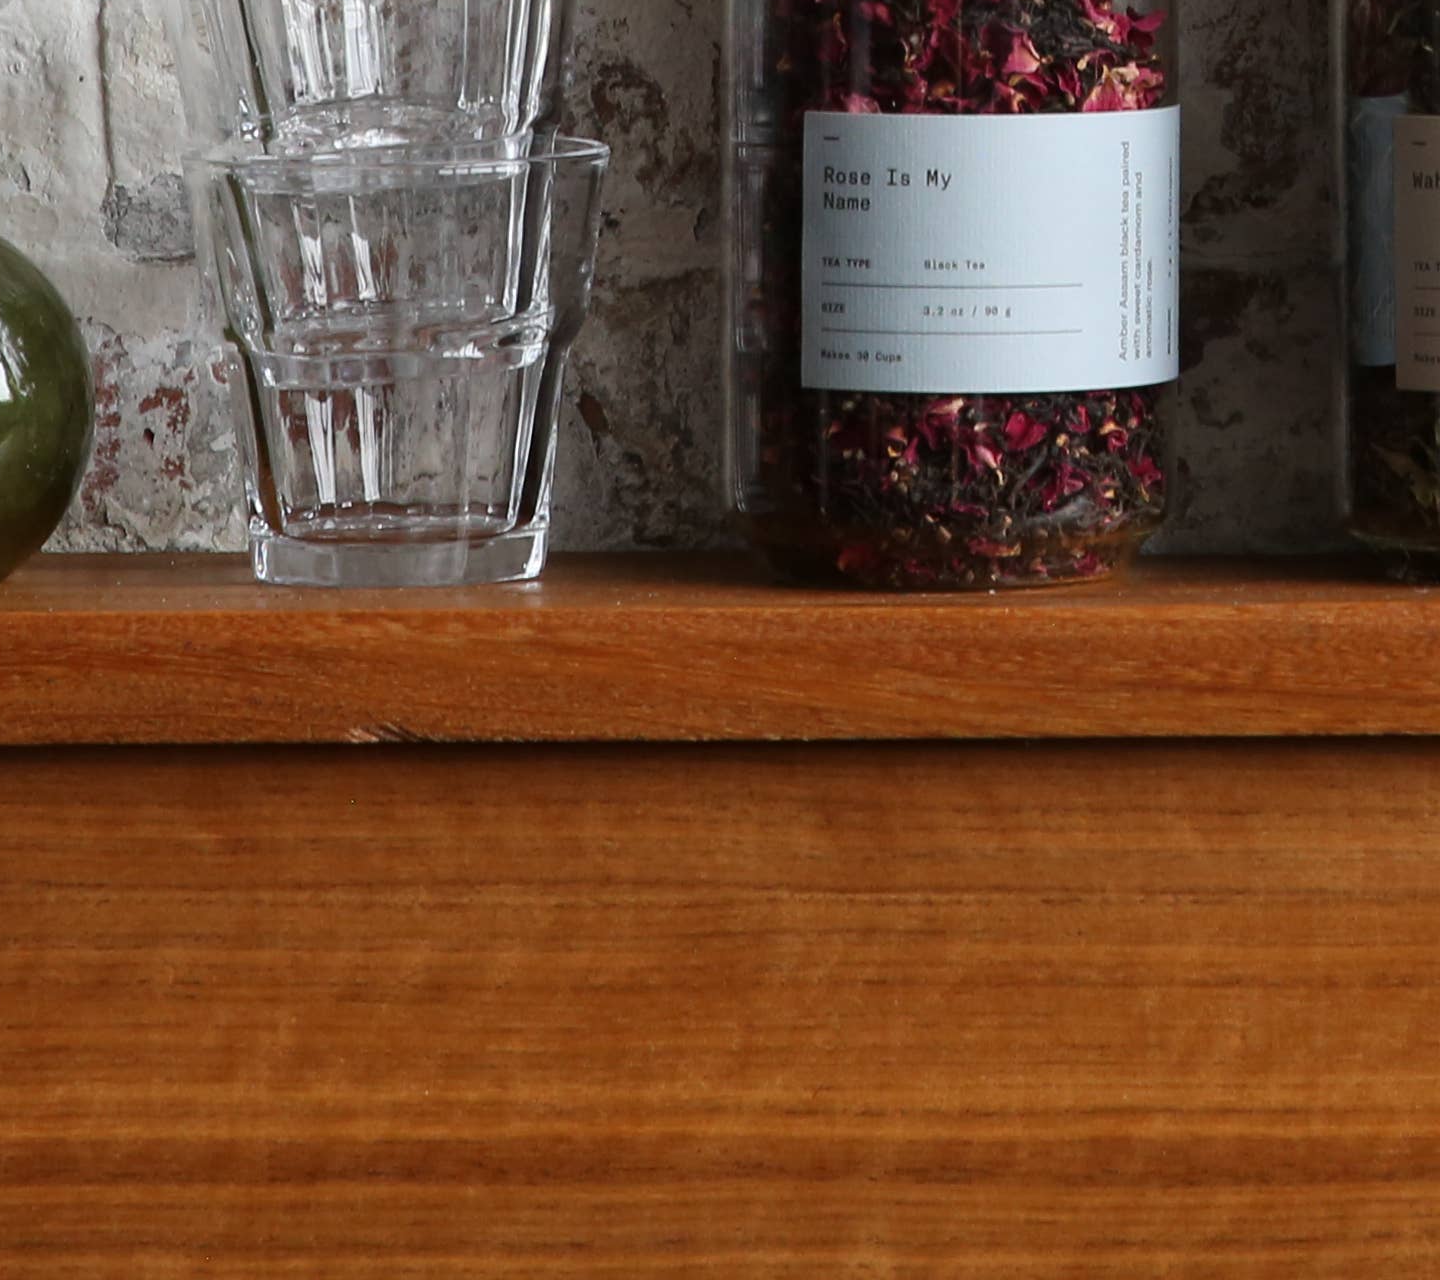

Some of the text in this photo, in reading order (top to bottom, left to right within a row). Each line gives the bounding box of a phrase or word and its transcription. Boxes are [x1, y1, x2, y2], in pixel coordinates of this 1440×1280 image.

[824, 166, 951, 191] Rose Is My
[1135, 172, 1143, 198] and
[824, 192, 870, 211] Name
[1135, 203, 1143, 279] cardamom
[1119, 141, 1131, 361] Amber Assam black tea paired
[822, 257, 870, 269] TEA TYPE
[924, 260, 985, 270] Black Tea
[822, 303, 844, 314] SIZE
[923, 306, 944, 317] 3.2
[1134, 330, 1142, 360] with
[876, 351, 902, 363] Cups
